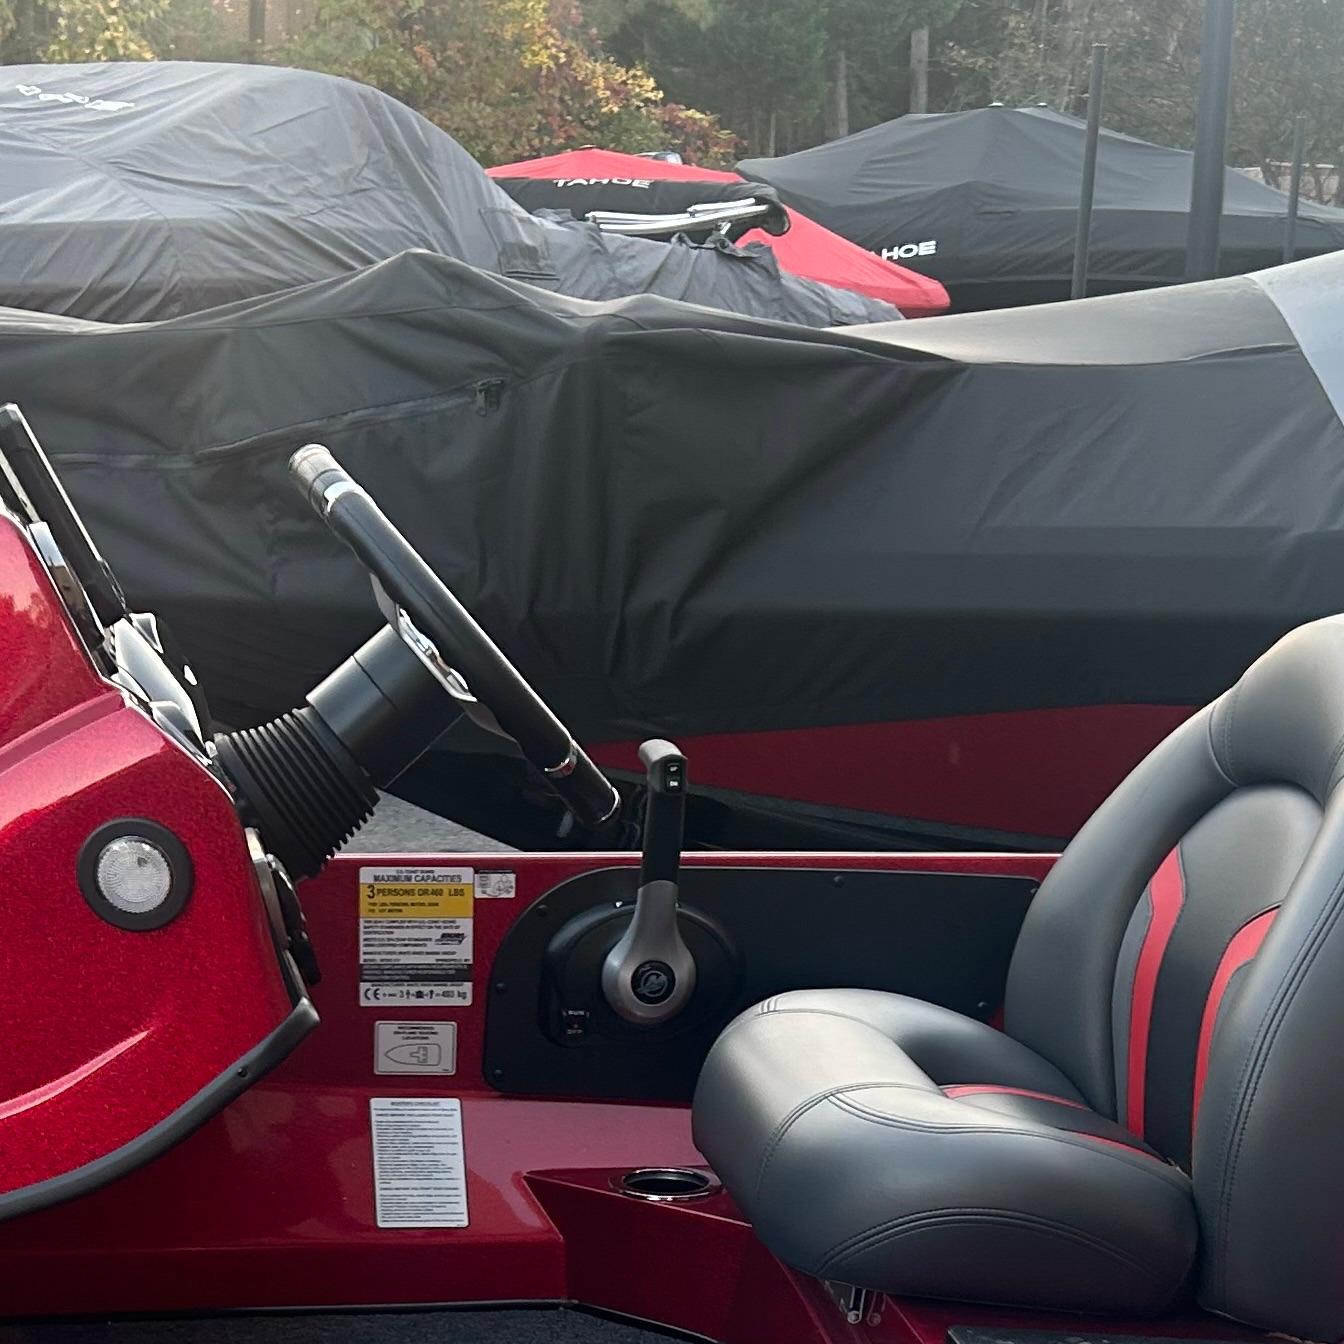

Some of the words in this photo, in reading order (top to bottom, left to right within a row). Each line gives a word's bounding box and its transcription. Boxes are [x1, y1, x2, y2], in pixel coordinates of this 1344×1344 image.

[552, 177, 655, 189] TAHOE
[878, 240, 937, 262] HOE
[373, 874, 413, 882] MAXIMUM
[414, 874, 463, 883] CAPACITIES
[367, 884, 376, 899] 3
[376, 888, 415, 897] PERSONS
[417, 888, 430, 897] OR
[448, 888, 465, 897] LBS
